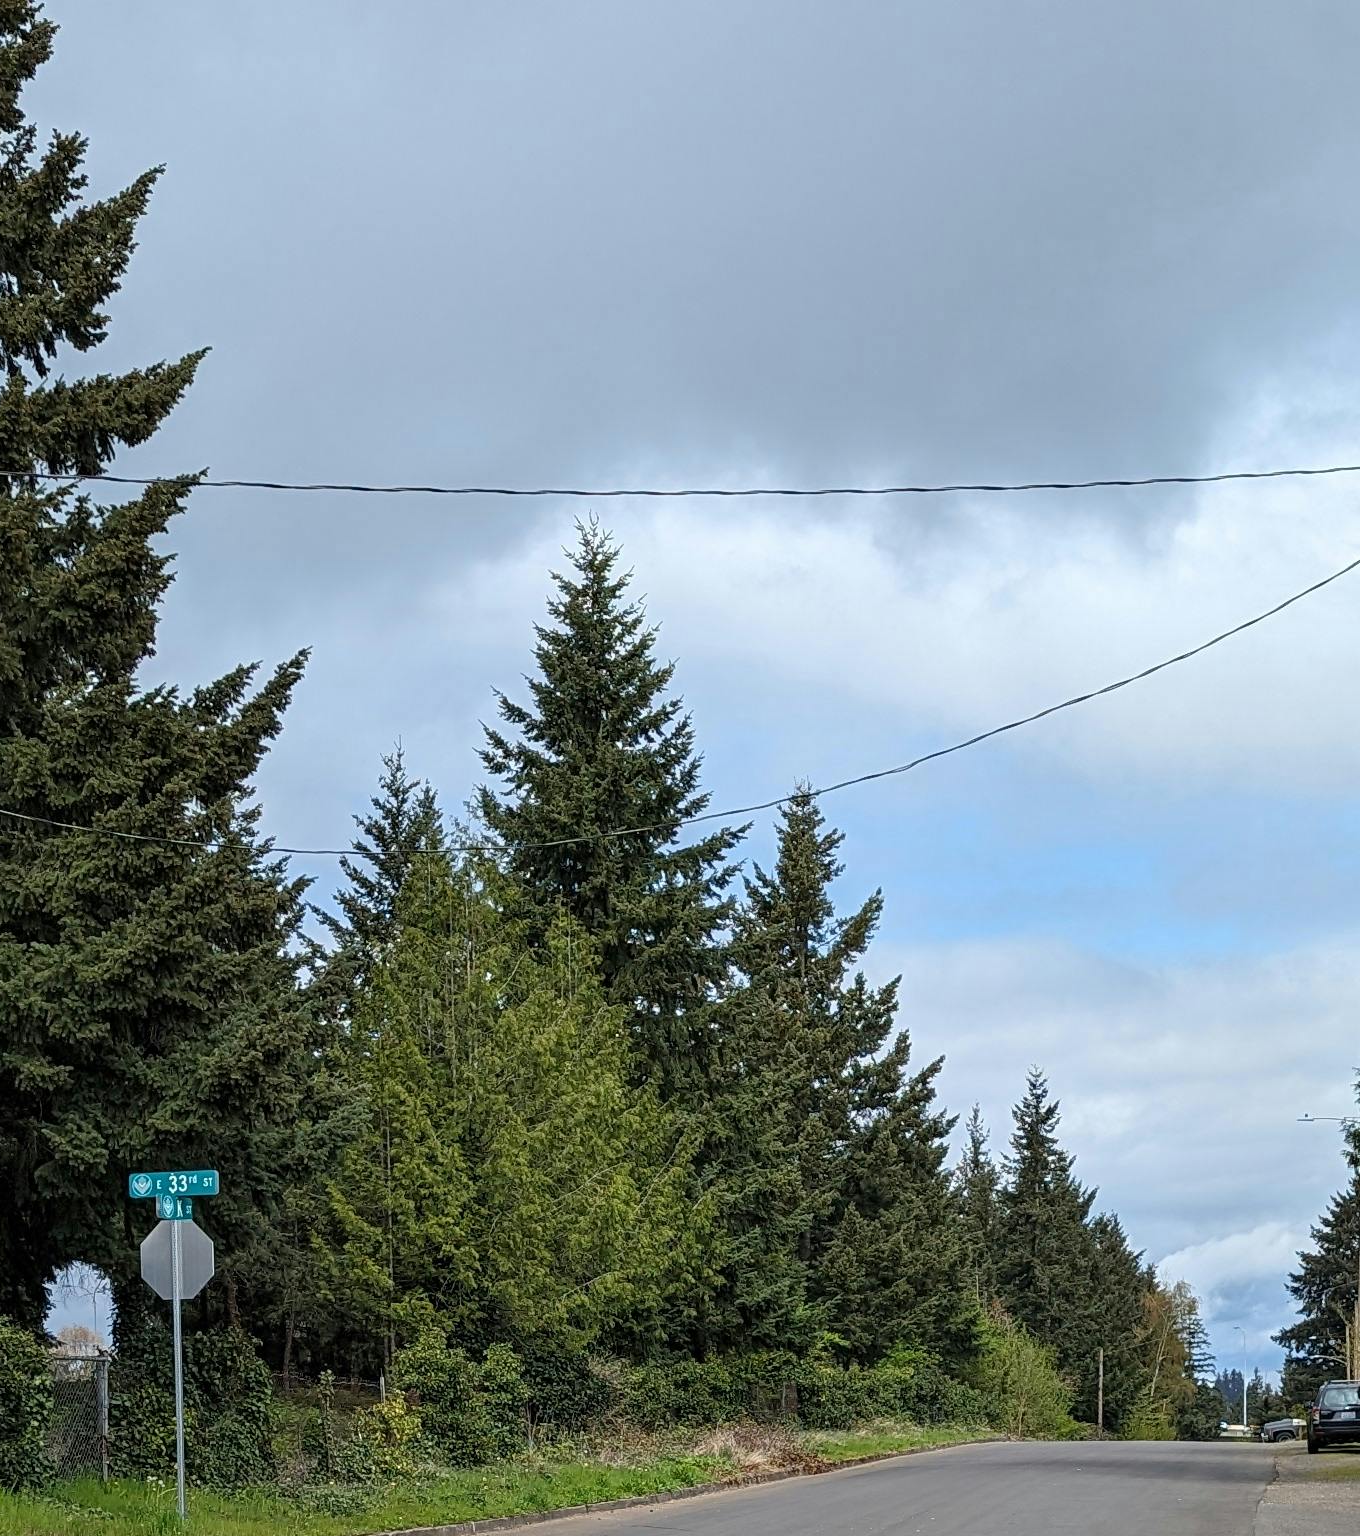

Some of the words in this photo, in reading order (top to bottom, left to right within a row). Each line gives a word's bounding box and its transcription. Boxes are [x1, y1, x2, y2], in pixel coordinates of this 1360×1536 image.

[157, 1180, 162, 1189] E
[168, 1174, 198, 1193] 33rd
[202, 1177, 213, 1187] ST
[177, 1200, 183, 1217] K
